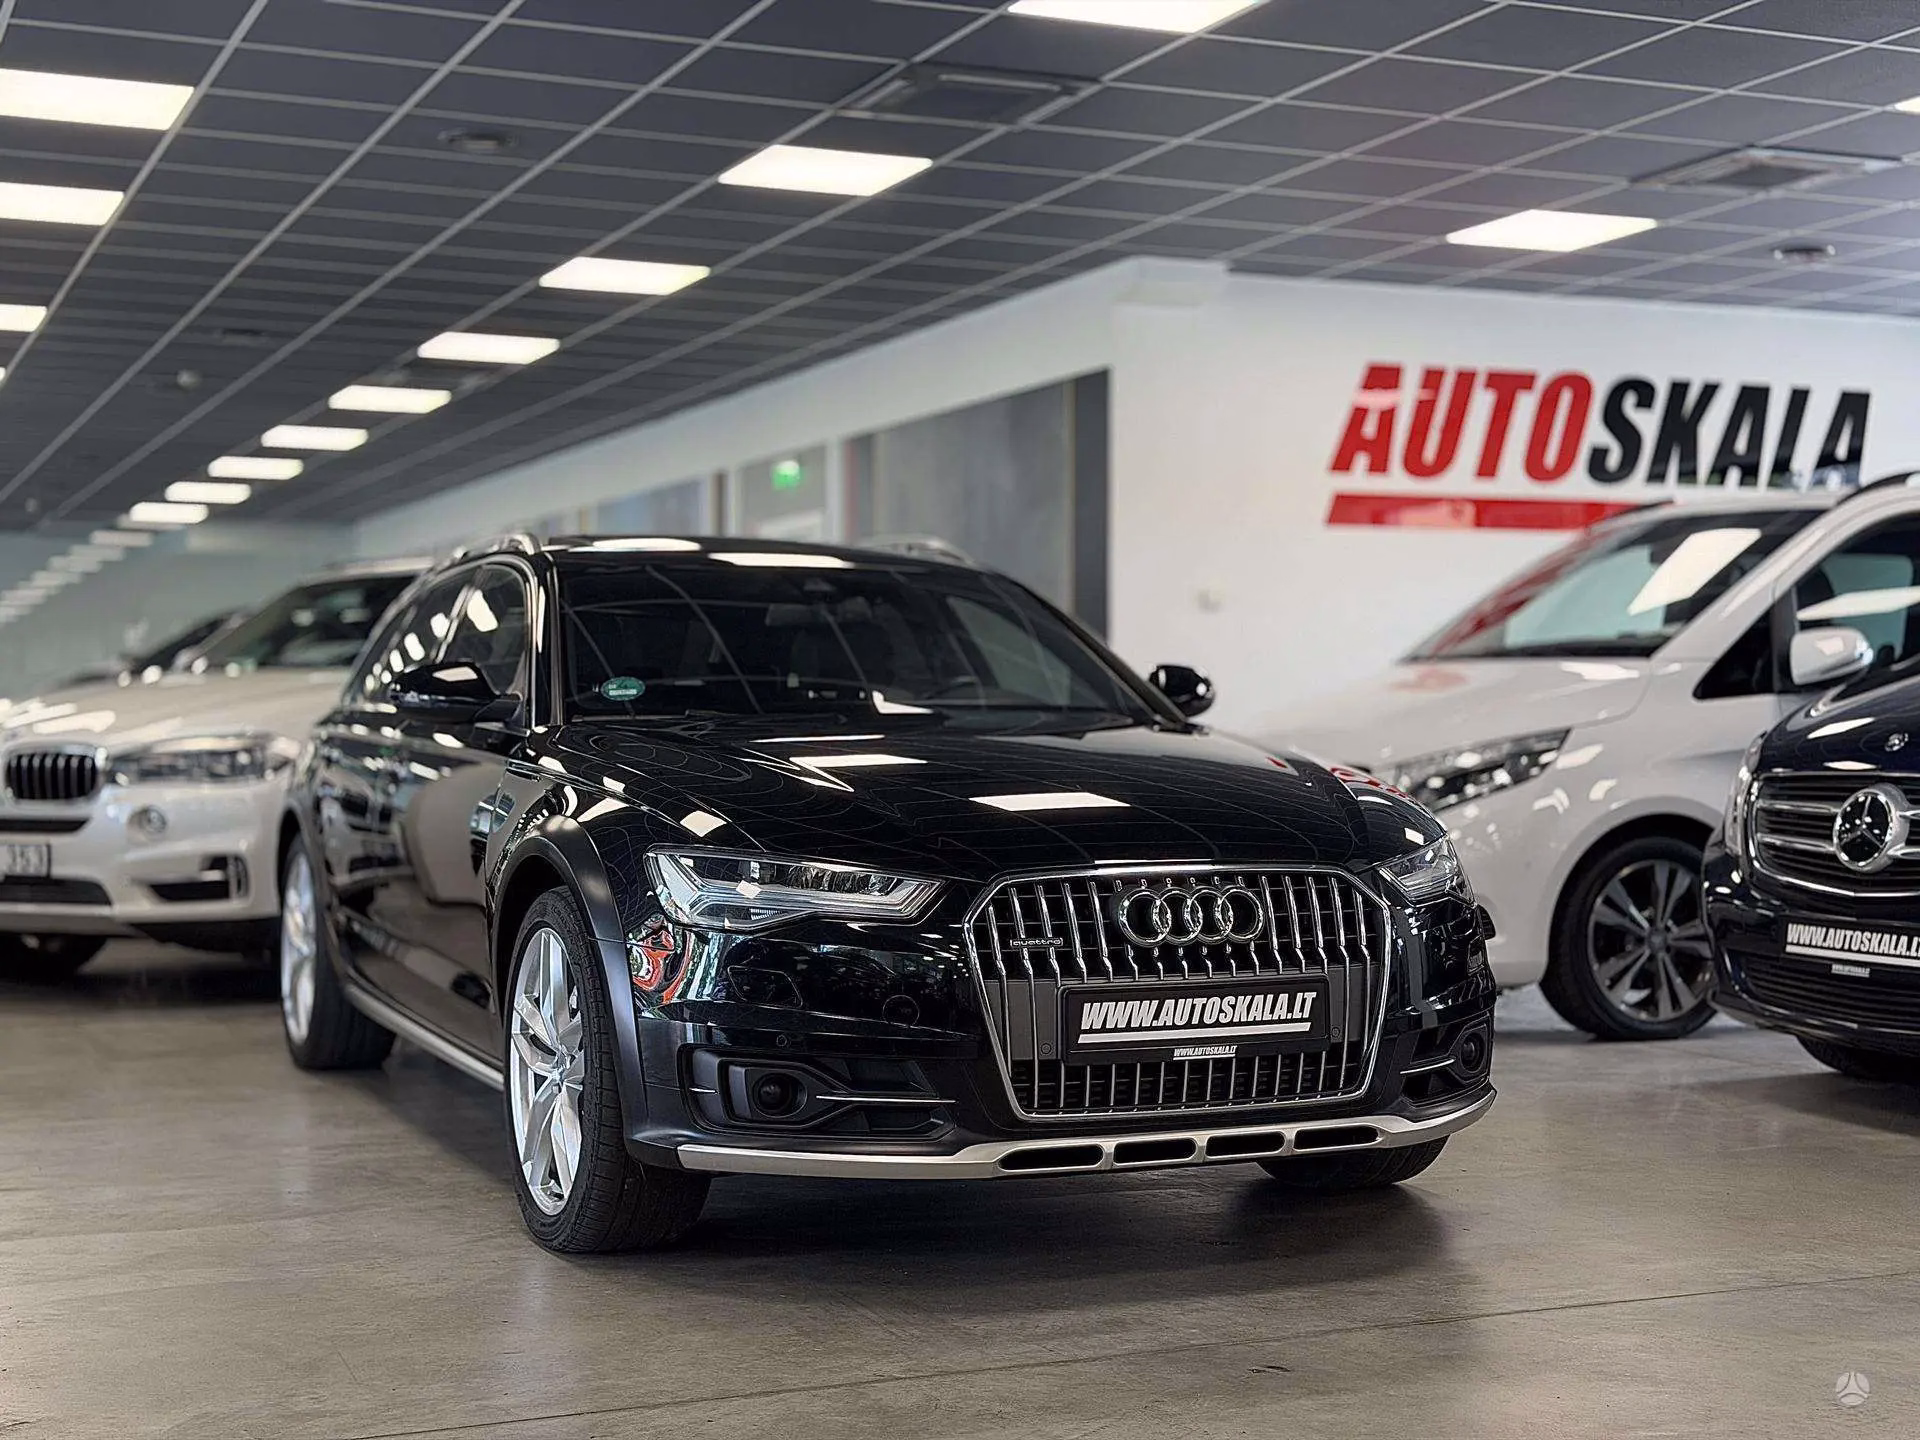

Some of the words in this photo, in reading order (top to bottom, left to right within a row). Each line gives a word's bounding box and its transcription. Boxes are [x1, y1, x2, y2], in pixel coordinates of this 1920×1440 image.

[1328, 362, 1872, 489] AUTOSKALA
[1012, 938, 1062, 947] quattro
[1787, 923, 1920, 957] WWW.AUTOSKALA.L
[1081, 992, 1317, 1030] WWW.AUTOSKALA.LT
[1174, 1045, 1237, 1057] WWW.AUTOSKALA.LT
